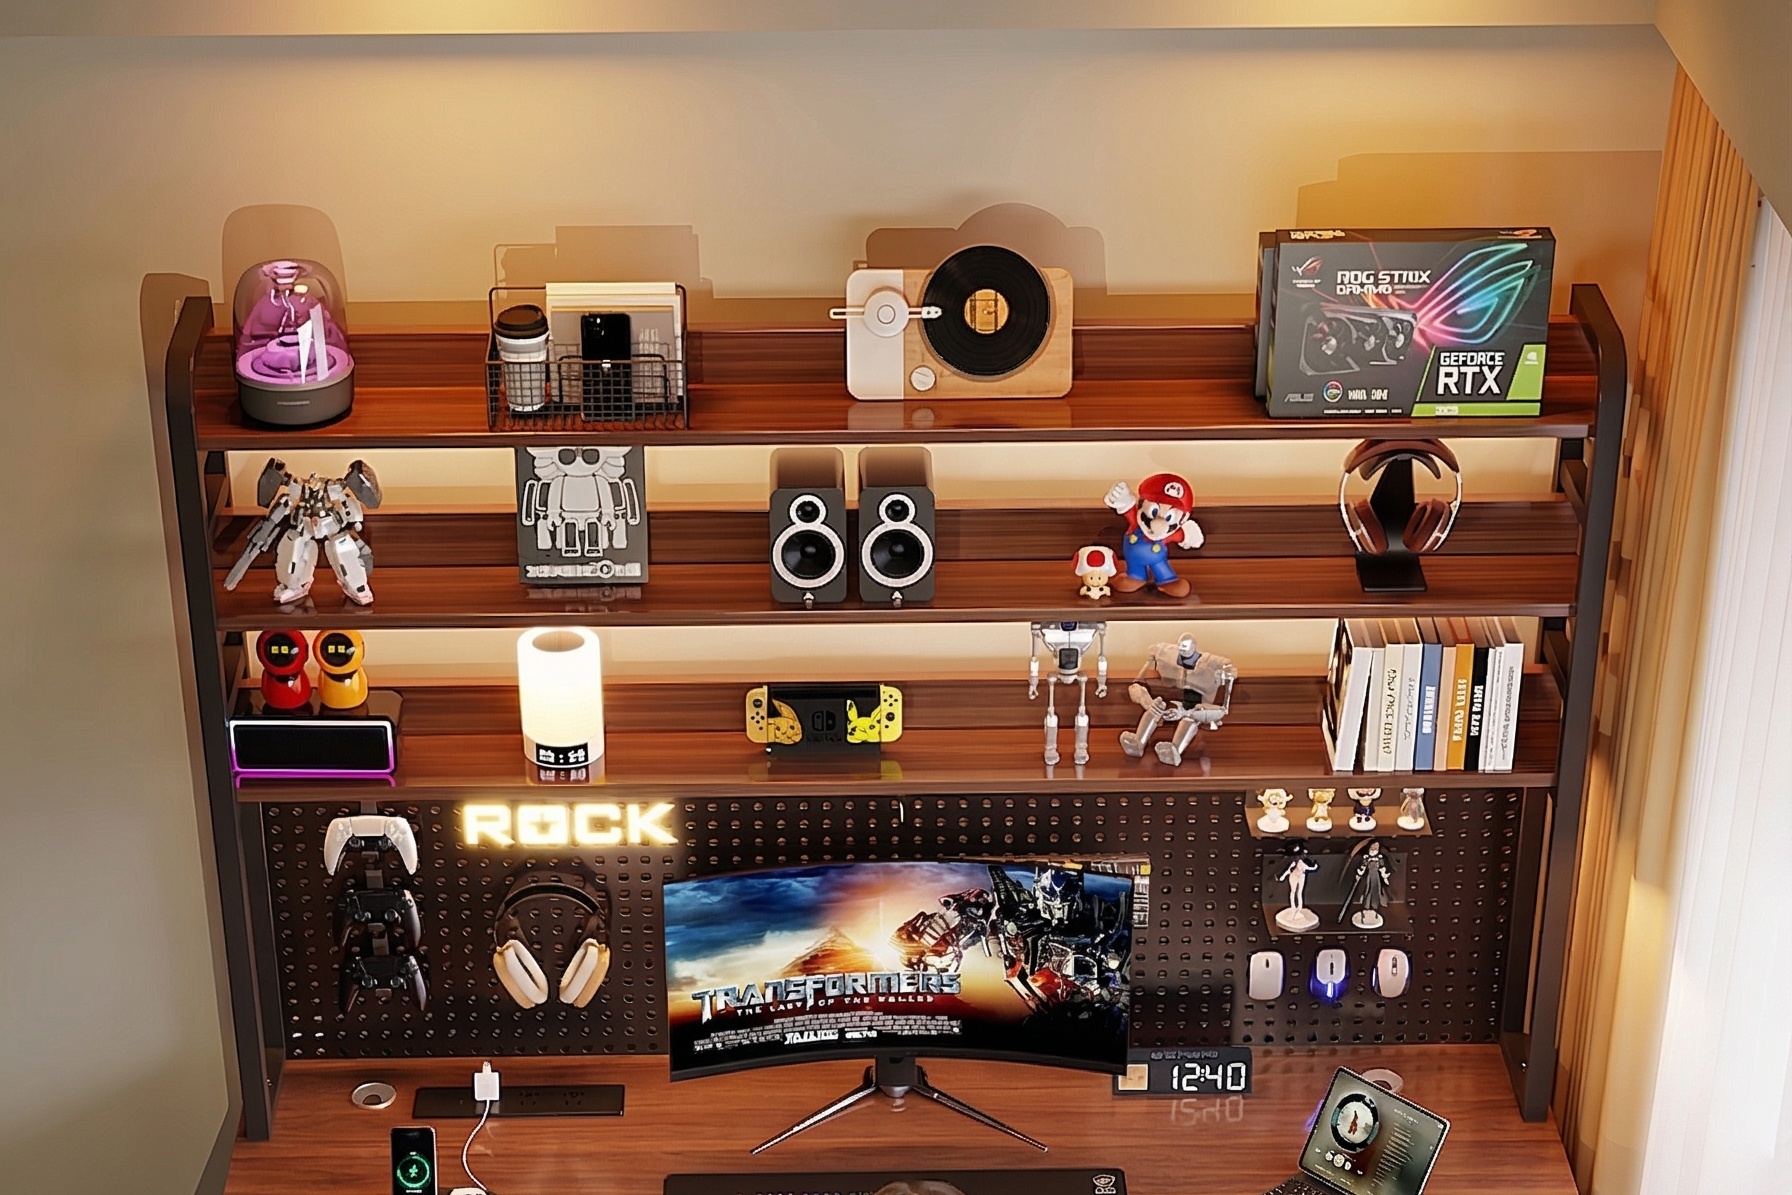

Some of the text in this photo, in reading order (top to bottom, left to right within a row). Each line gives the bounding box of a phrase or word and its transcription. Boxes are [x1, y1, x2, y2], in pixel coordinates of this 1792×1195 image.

[1440, 351, 1505, 365] GEFORCE
[1437, 365, 1502, 394] RTX
[463, 803, 679, 845] ROCK
[691, 971, 961, 1025] TRANSFORMERS
[1171, 1062, 1247, 1092] 12:40
